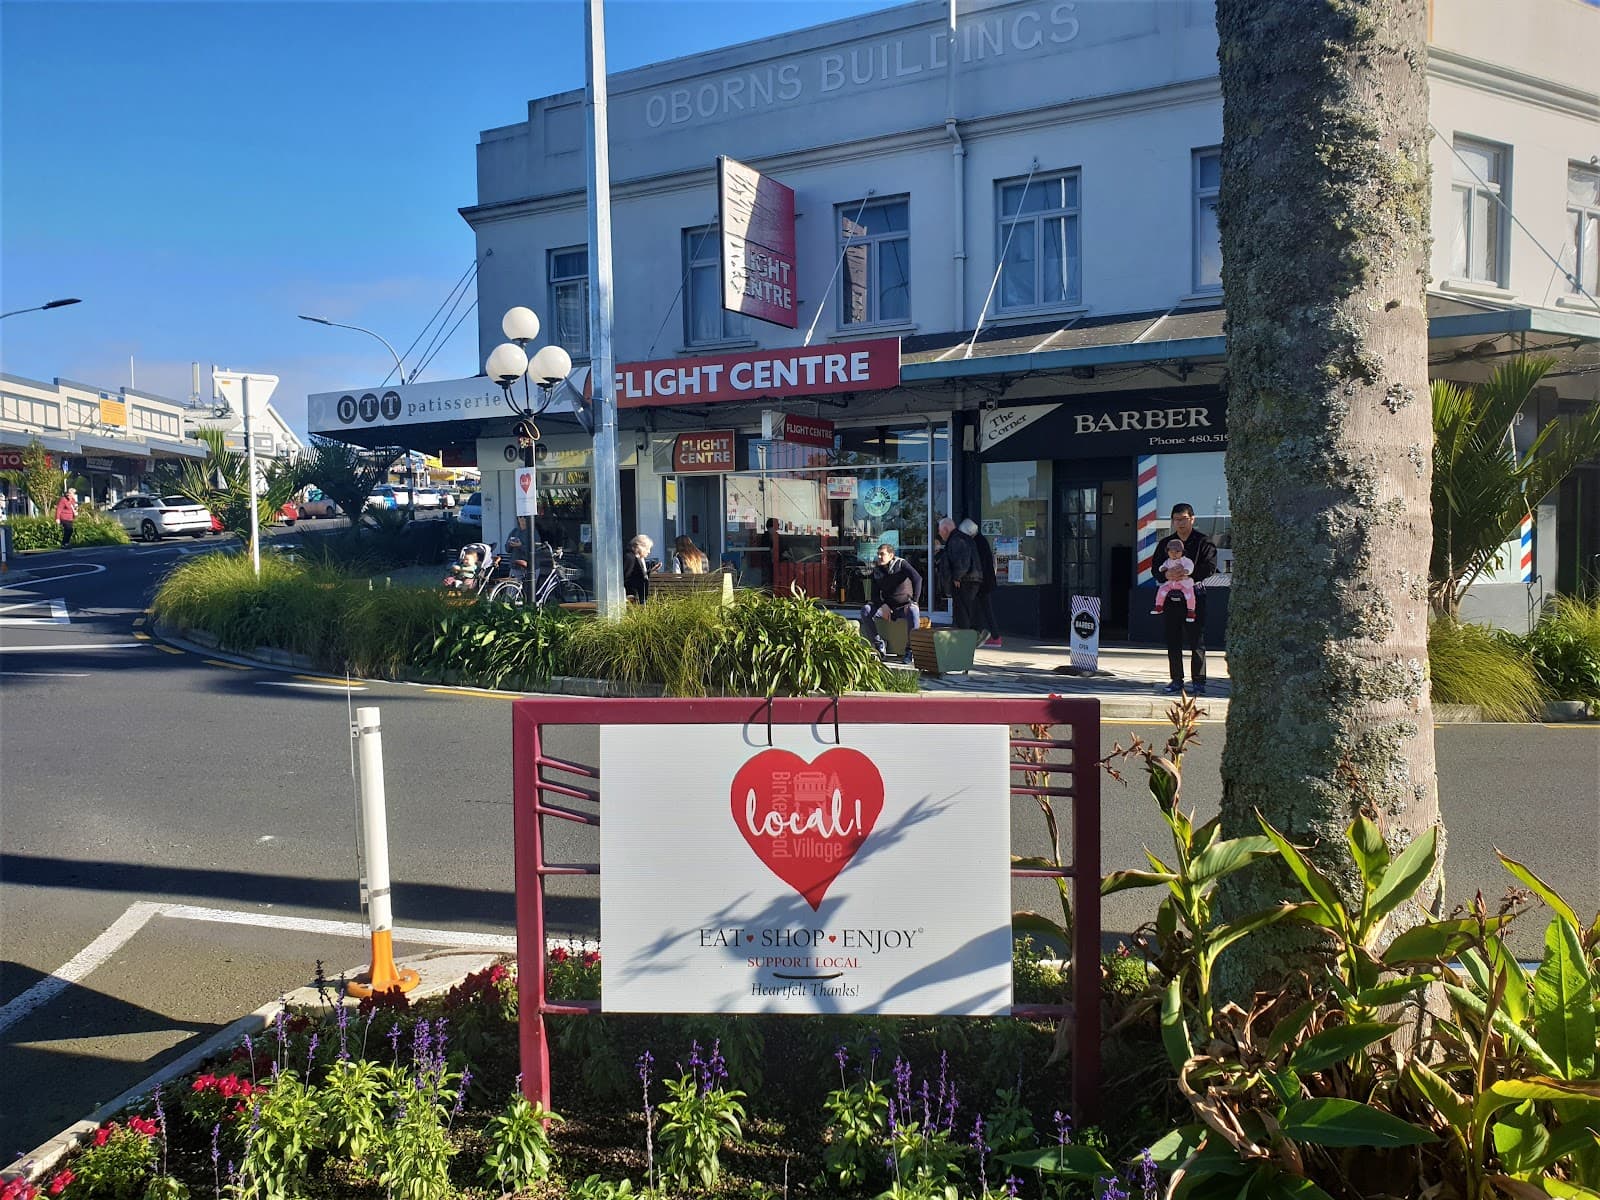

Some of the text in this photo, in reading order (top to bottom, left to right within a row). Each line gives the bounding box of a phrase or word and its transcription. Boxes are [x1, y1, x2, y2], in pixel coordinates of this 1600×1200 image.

[645, 2, 1081, 129] OBORNS BUILDINGS
[729, 351, 870, 391] CENTRE
[339, 392, 501, 422] OTT patisserie
[988, 414, 1027, 440] Corner
[990, 411, 1015, 427] The
[1073, 407, 1212, 435] BARBER
[786, 423, 833, 439] FLIGHT CENTRE
[1148, 435, 1185, 446] Phone
[506, 444, 546, 461] OT
[681, 438, 729, 452] FLIGHT
[680, 451, 730, 465] CENTRE
[745, 788, 862, 839] local!
[772, 771, 793, 858] Birkead
[793, 838, 843, 863] Village
[699, 928, 745, 947] EAT
[761, 928, 825, 948] SHOP
[747, 956, 861, 968] SUPPORT LOCAL
[751, 982, 859, 1000] Heartfelt Thanks!
